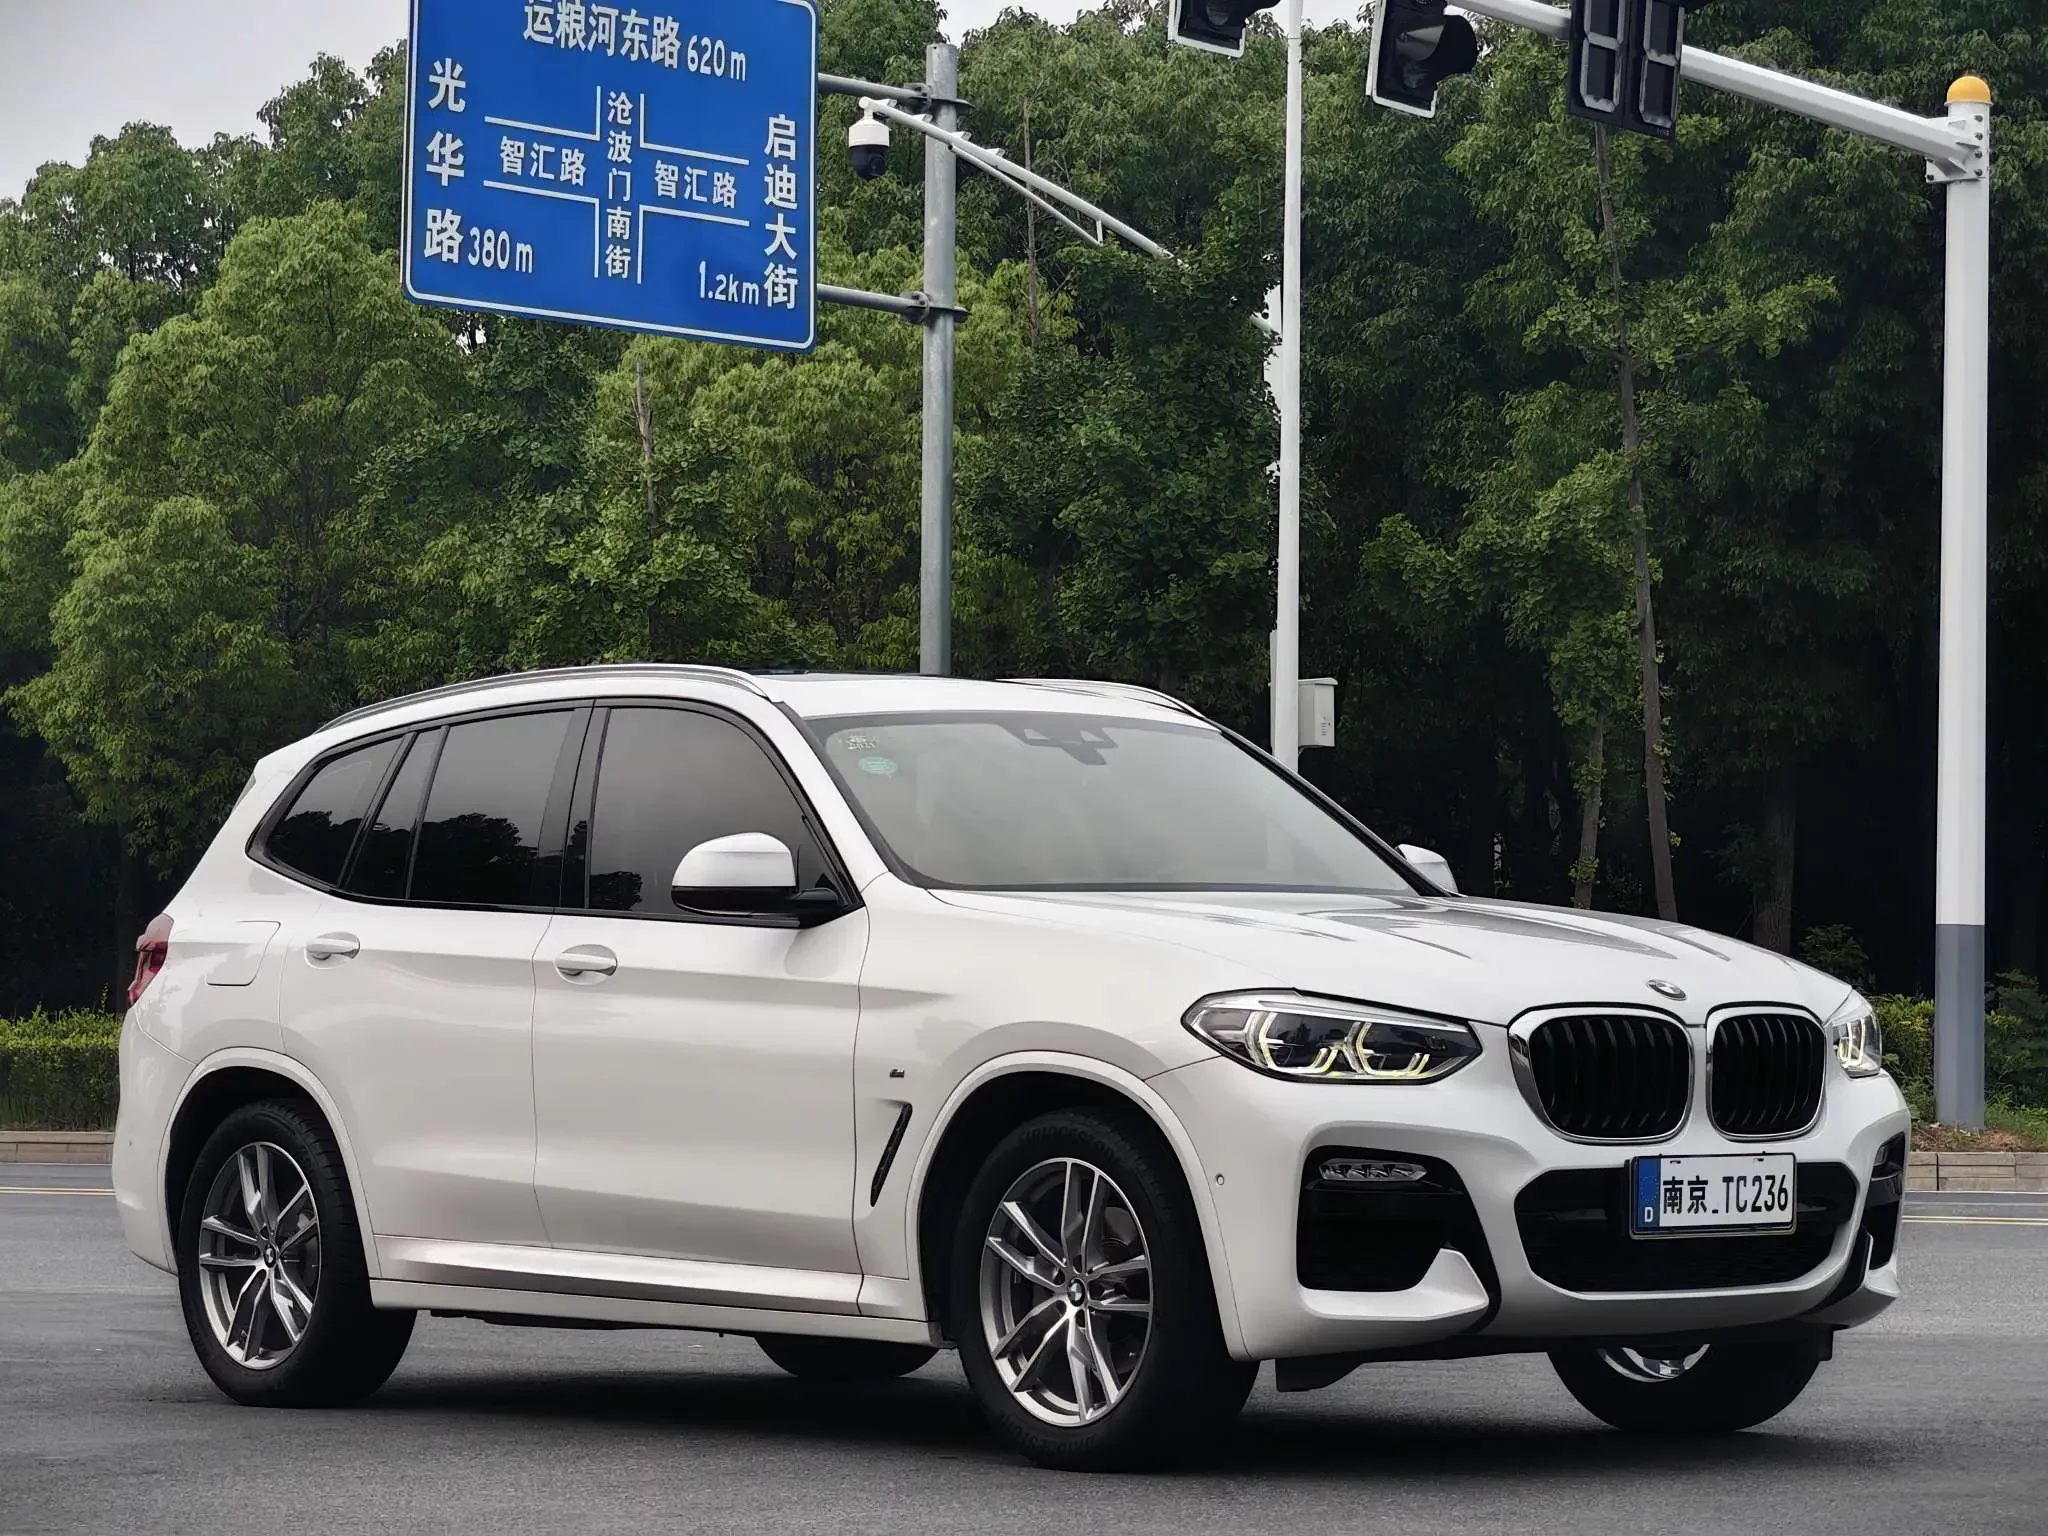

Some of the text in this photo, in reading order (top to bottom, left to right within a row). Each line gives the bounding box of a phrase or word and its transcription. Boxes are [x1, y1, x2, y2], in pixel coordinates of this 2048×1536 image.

[523, 0, 682, 69] 运粮河东路
[424, 57, 467, 264] 光华路
[500, 135, 586, 186] 智汇路
[604, 91, 633, 279] 沧波门南街
[654, 159, 738, 209] 智汇路
[764, 113, 799, 310] 启迪大街
[699, 260, 760, 305] 1.2km
[1644, 1206, 1654, 1223] D
